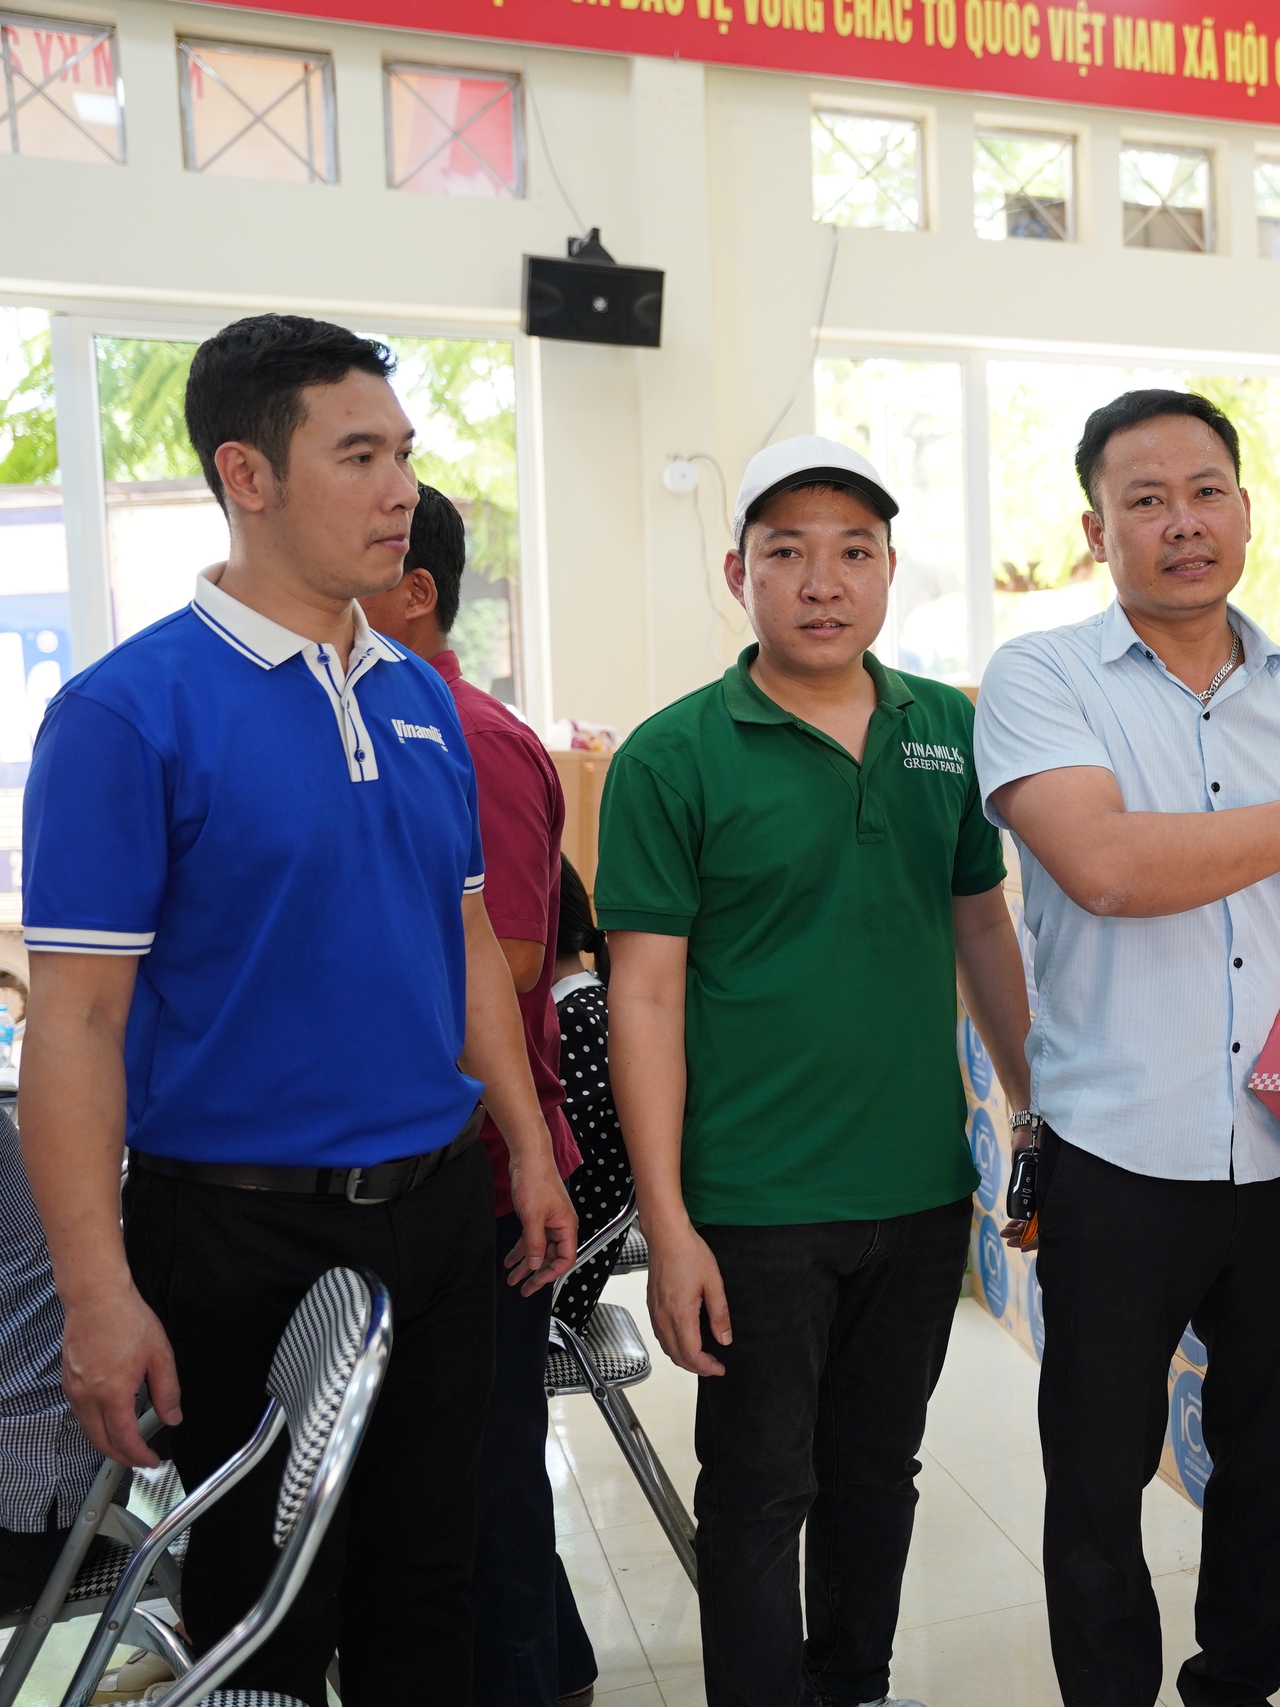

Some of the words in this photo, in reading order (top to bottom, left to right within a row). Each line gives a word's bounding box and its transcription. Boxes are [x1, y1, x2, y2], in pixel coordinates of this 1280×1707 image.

[1046, 0, 1106, 77] VIỆT
[1112, 15, 1175, 75] NAM
[1182, 17, 1219, 80] XÃ
[1224, 21, 1268, 97] HỘI
[391, 718, 445, 745] Vinamilk
[901, 741, 962, 762] VINAMILK
[903, 757, 940, 770] GREEN
[939, 760, 964, 775] FARM
[1180, 1397, 1210, 1462] IC
